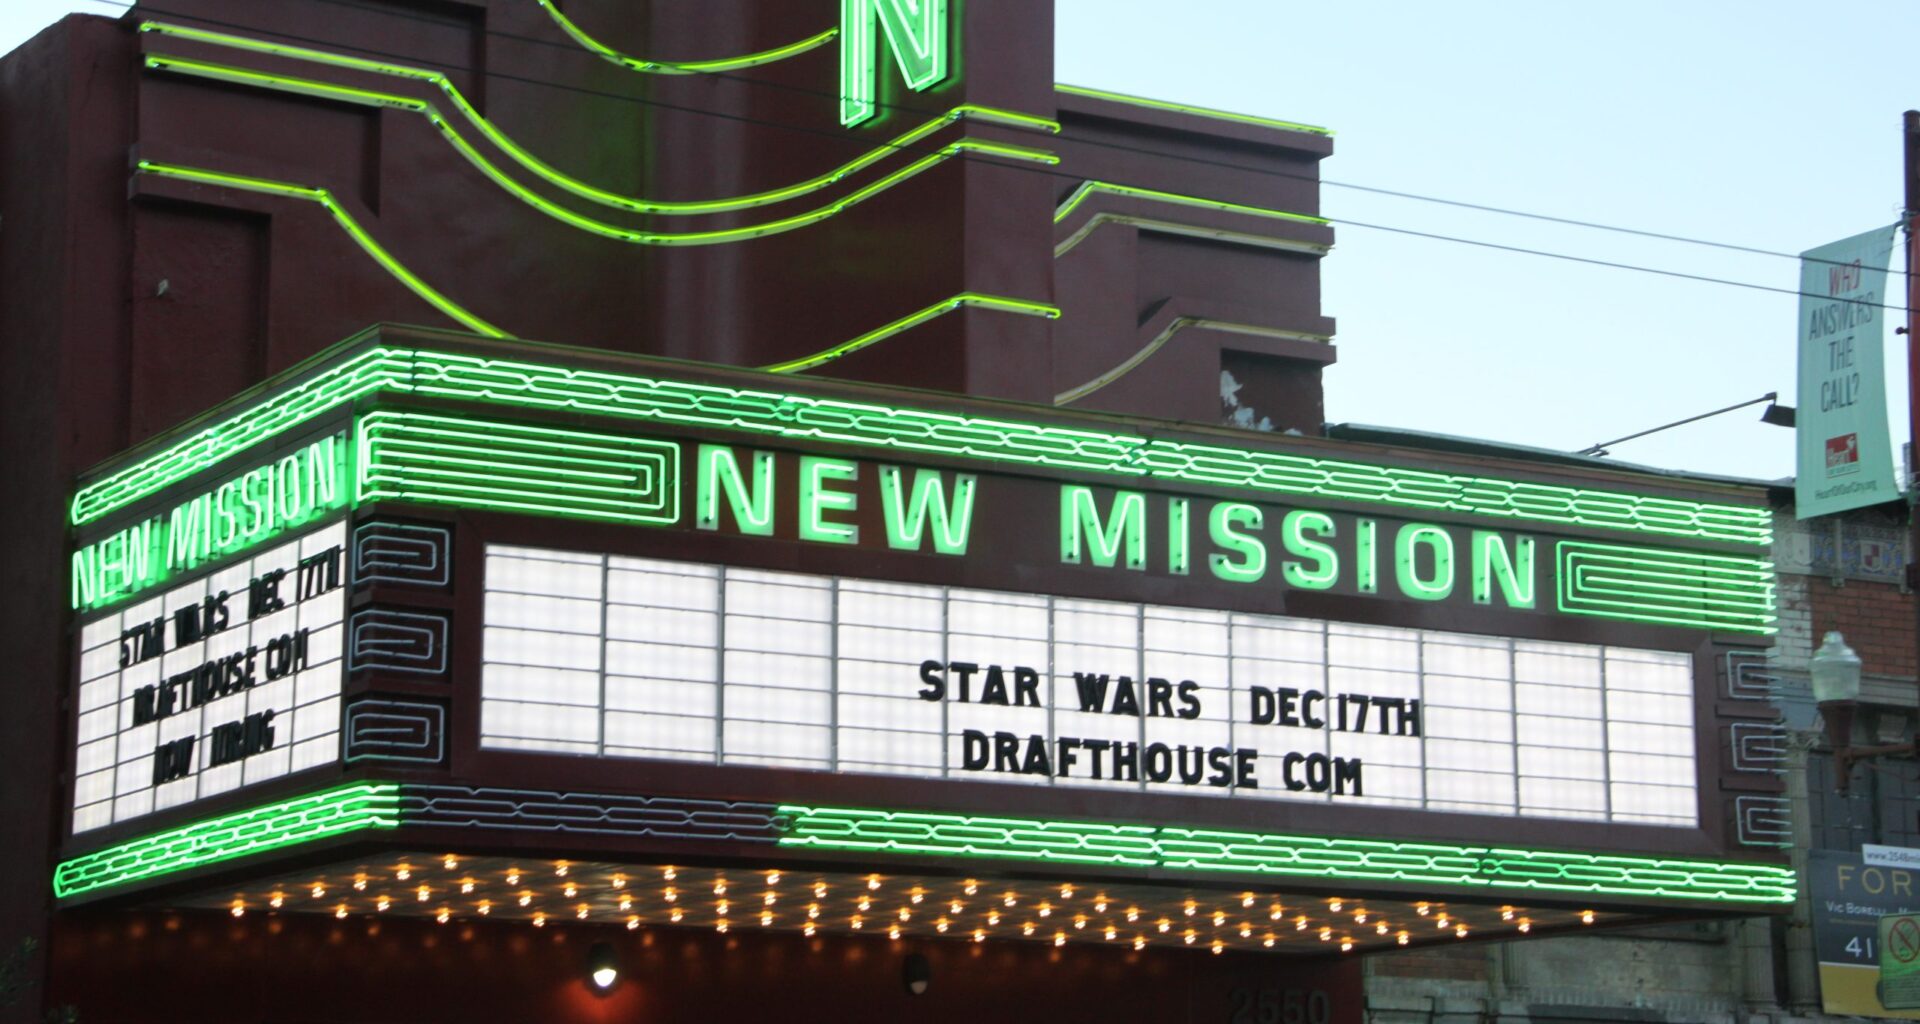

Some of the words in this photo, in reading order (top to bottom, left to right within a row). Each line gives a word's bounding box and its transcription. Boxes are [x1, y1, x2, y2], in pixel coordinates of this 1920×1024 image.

[1829, 258, 1861, 297] WHO
[1808, 291, 1875, 341] ANSWERS
[1828, 336, 1855, 372] THE
[1820, 372, 1860, 412] CALL?
[72, 514, 163, 612] NEW
[166, 430, 347, 572] MISSION
[696, 444, 978, 556] NEW
[1060, 485, 1536, 609] MISSION
[120, 616, 165, 668] STAR
[174, 590, 230, 649] WARS
[249, 568, 285, 620] DEC
[133, 646, 257, 728] DRAFTHOUSE
[266, 627, 309, 681] COM
[918, 660, 1041, 708] STAR
[1074, 671, 1202, 720] WARS
[1251, 685, 1325, 729] DEC
[1337, 693, 1420, 737] 17TH
[962, 729, 1259, 789] DRAFTHOUSE
[1283, 752, 1364, 796] COM
[1836, 864, 1913, 897] FOR
[1231, 988, 1332, 1024] 2550
